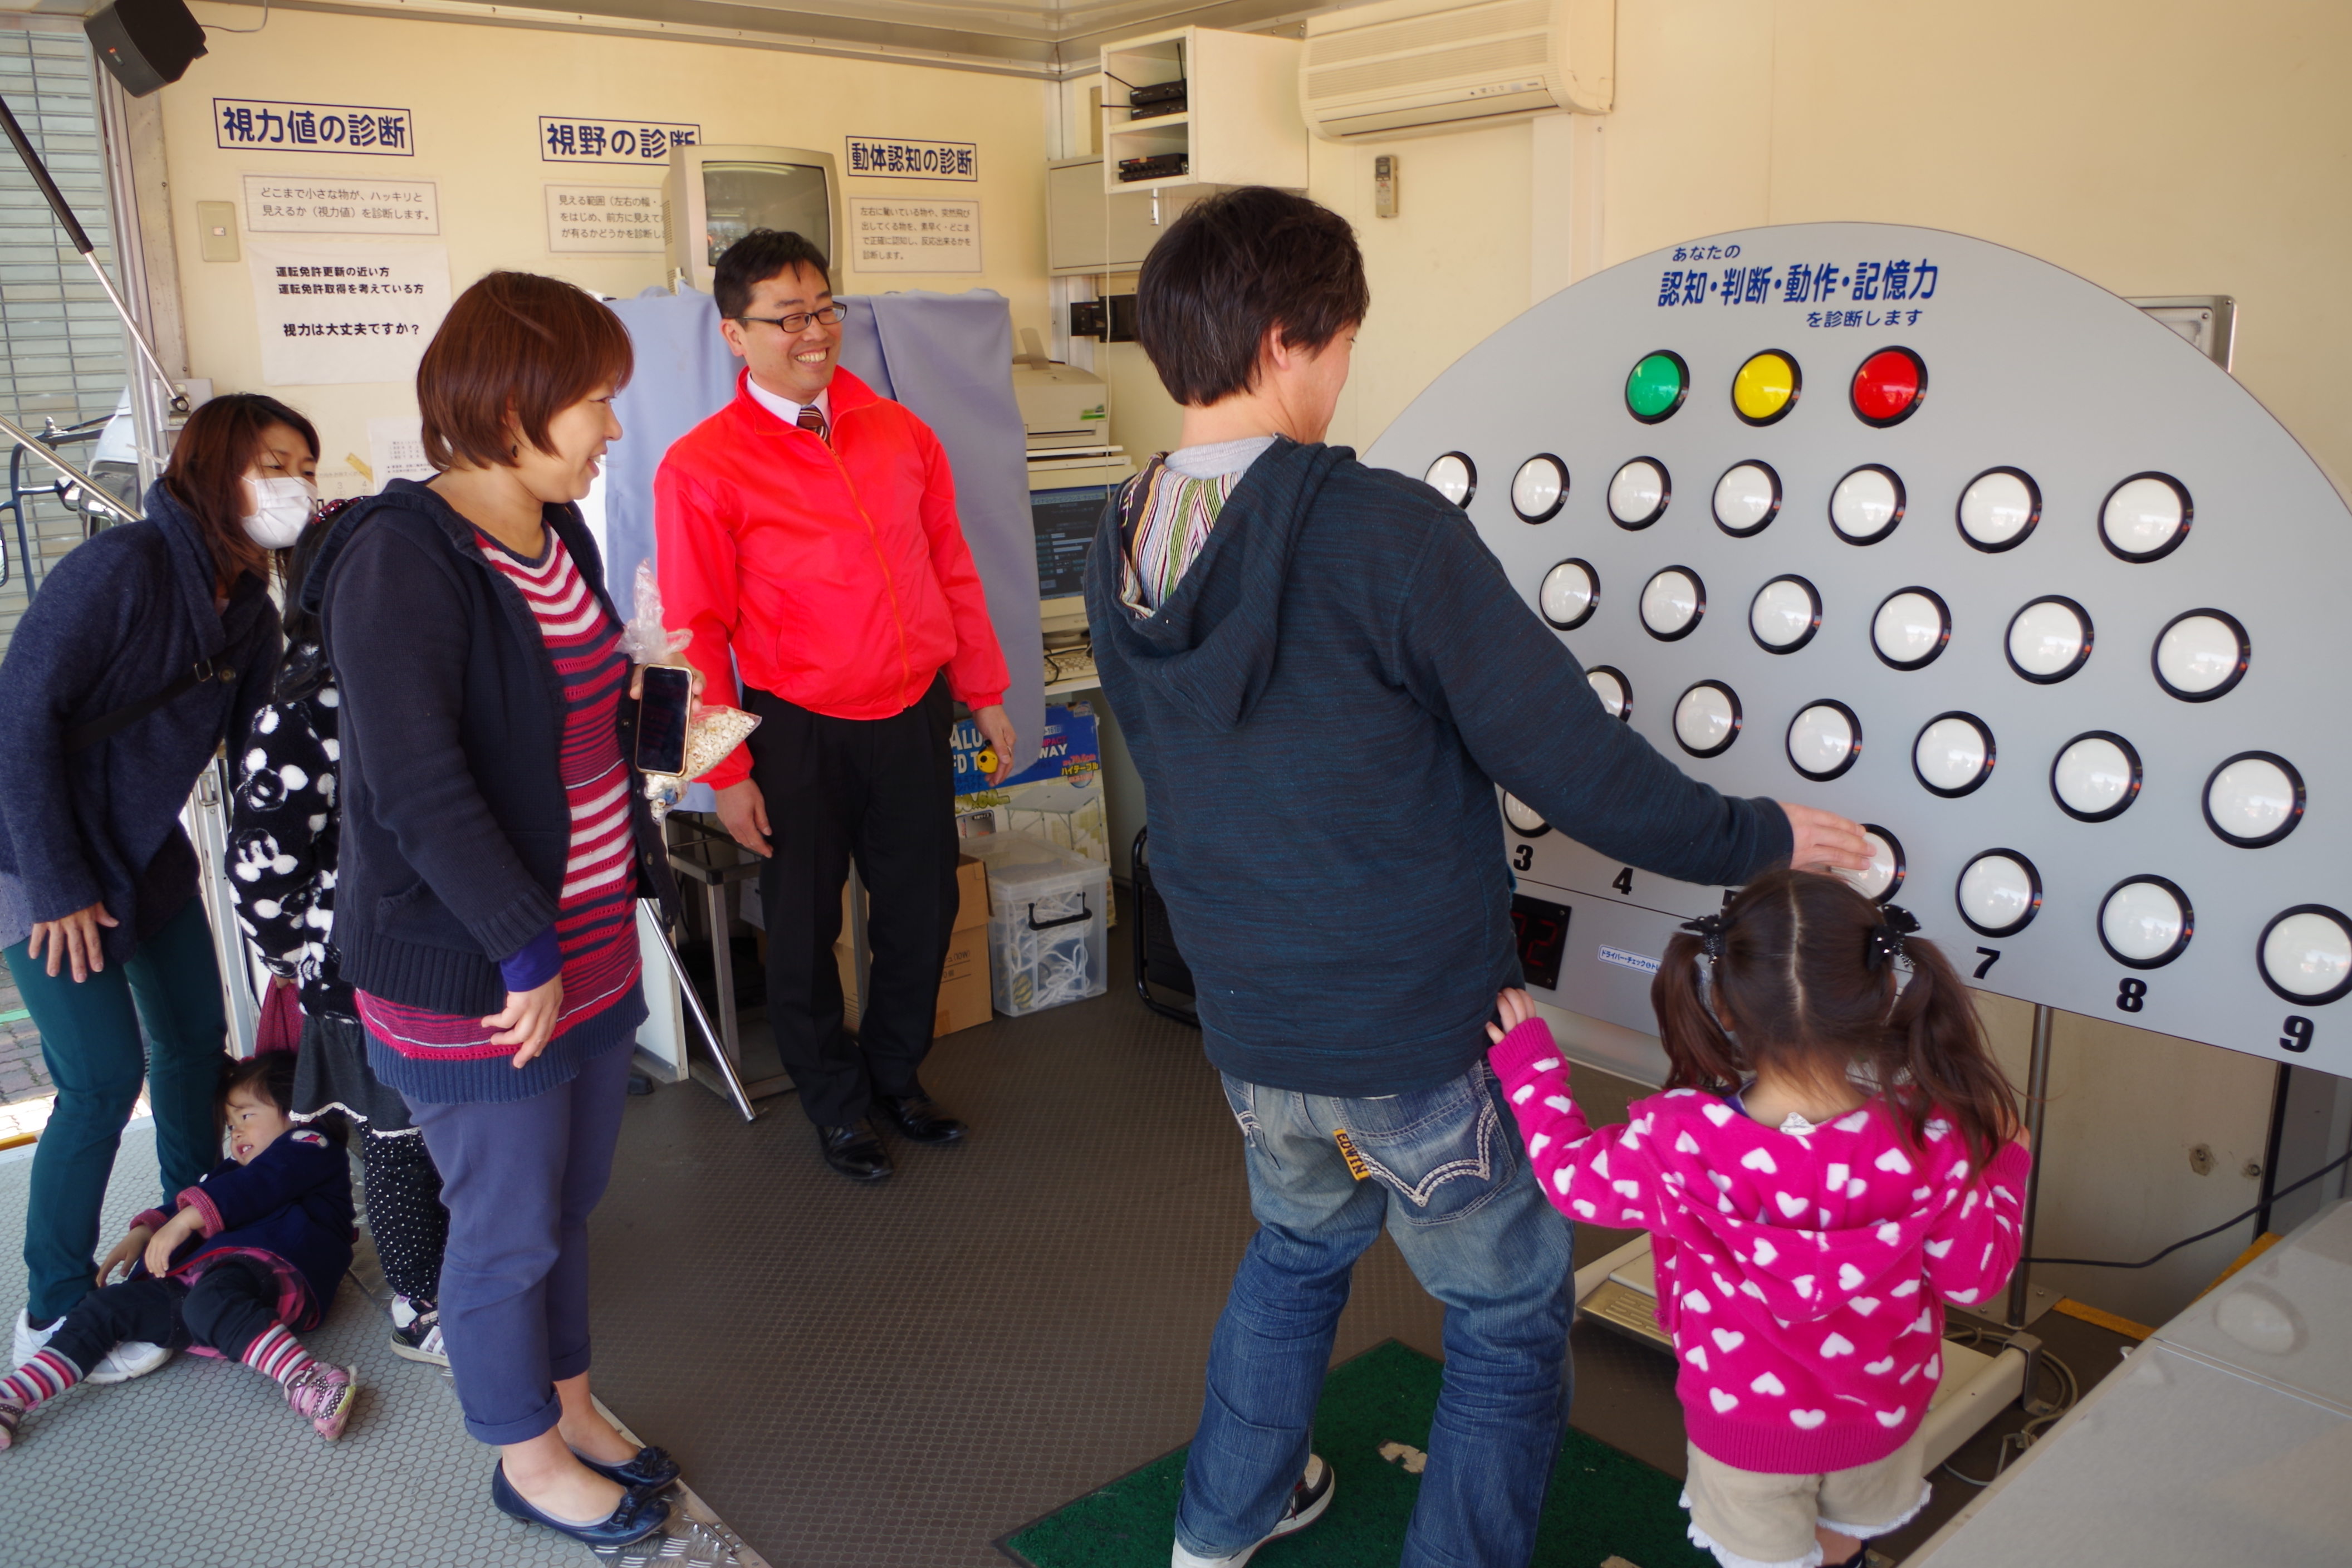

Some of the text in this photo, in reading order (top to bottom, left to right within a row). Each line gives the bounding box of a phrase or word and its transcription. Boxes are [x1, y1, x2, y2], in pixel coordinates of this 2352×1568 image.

[223, 106, 406, 149] 視力値の診断
[851, 143, 972, 175] 動体認知の診断
[560, 212, 663, 223] をはじめ、前方に見えて
[1672, 244, 1741, 262] あなたの
[276, 266, 390, 277] 運転免許更新の近い方
[1657, 258, 1939, 307] 認知・判断・動作・記憶力
[278, 284, 424, 294] 運転免許取得を考えている方
[283, 322, 420, 337] 視力は大丈夫ですか？
[1806, 310, 1924, 328] を診断します
[1513, 844, 1533, 871] 3
[1612, 867, 1633, 895] 4
[1972, 946, 2001, 979] 7
[2116, 977, 2148, 1013] 8
[2280, 1015, 2315, 1054] 9
[1336, 1133, 1368, 1175] EDWIN
